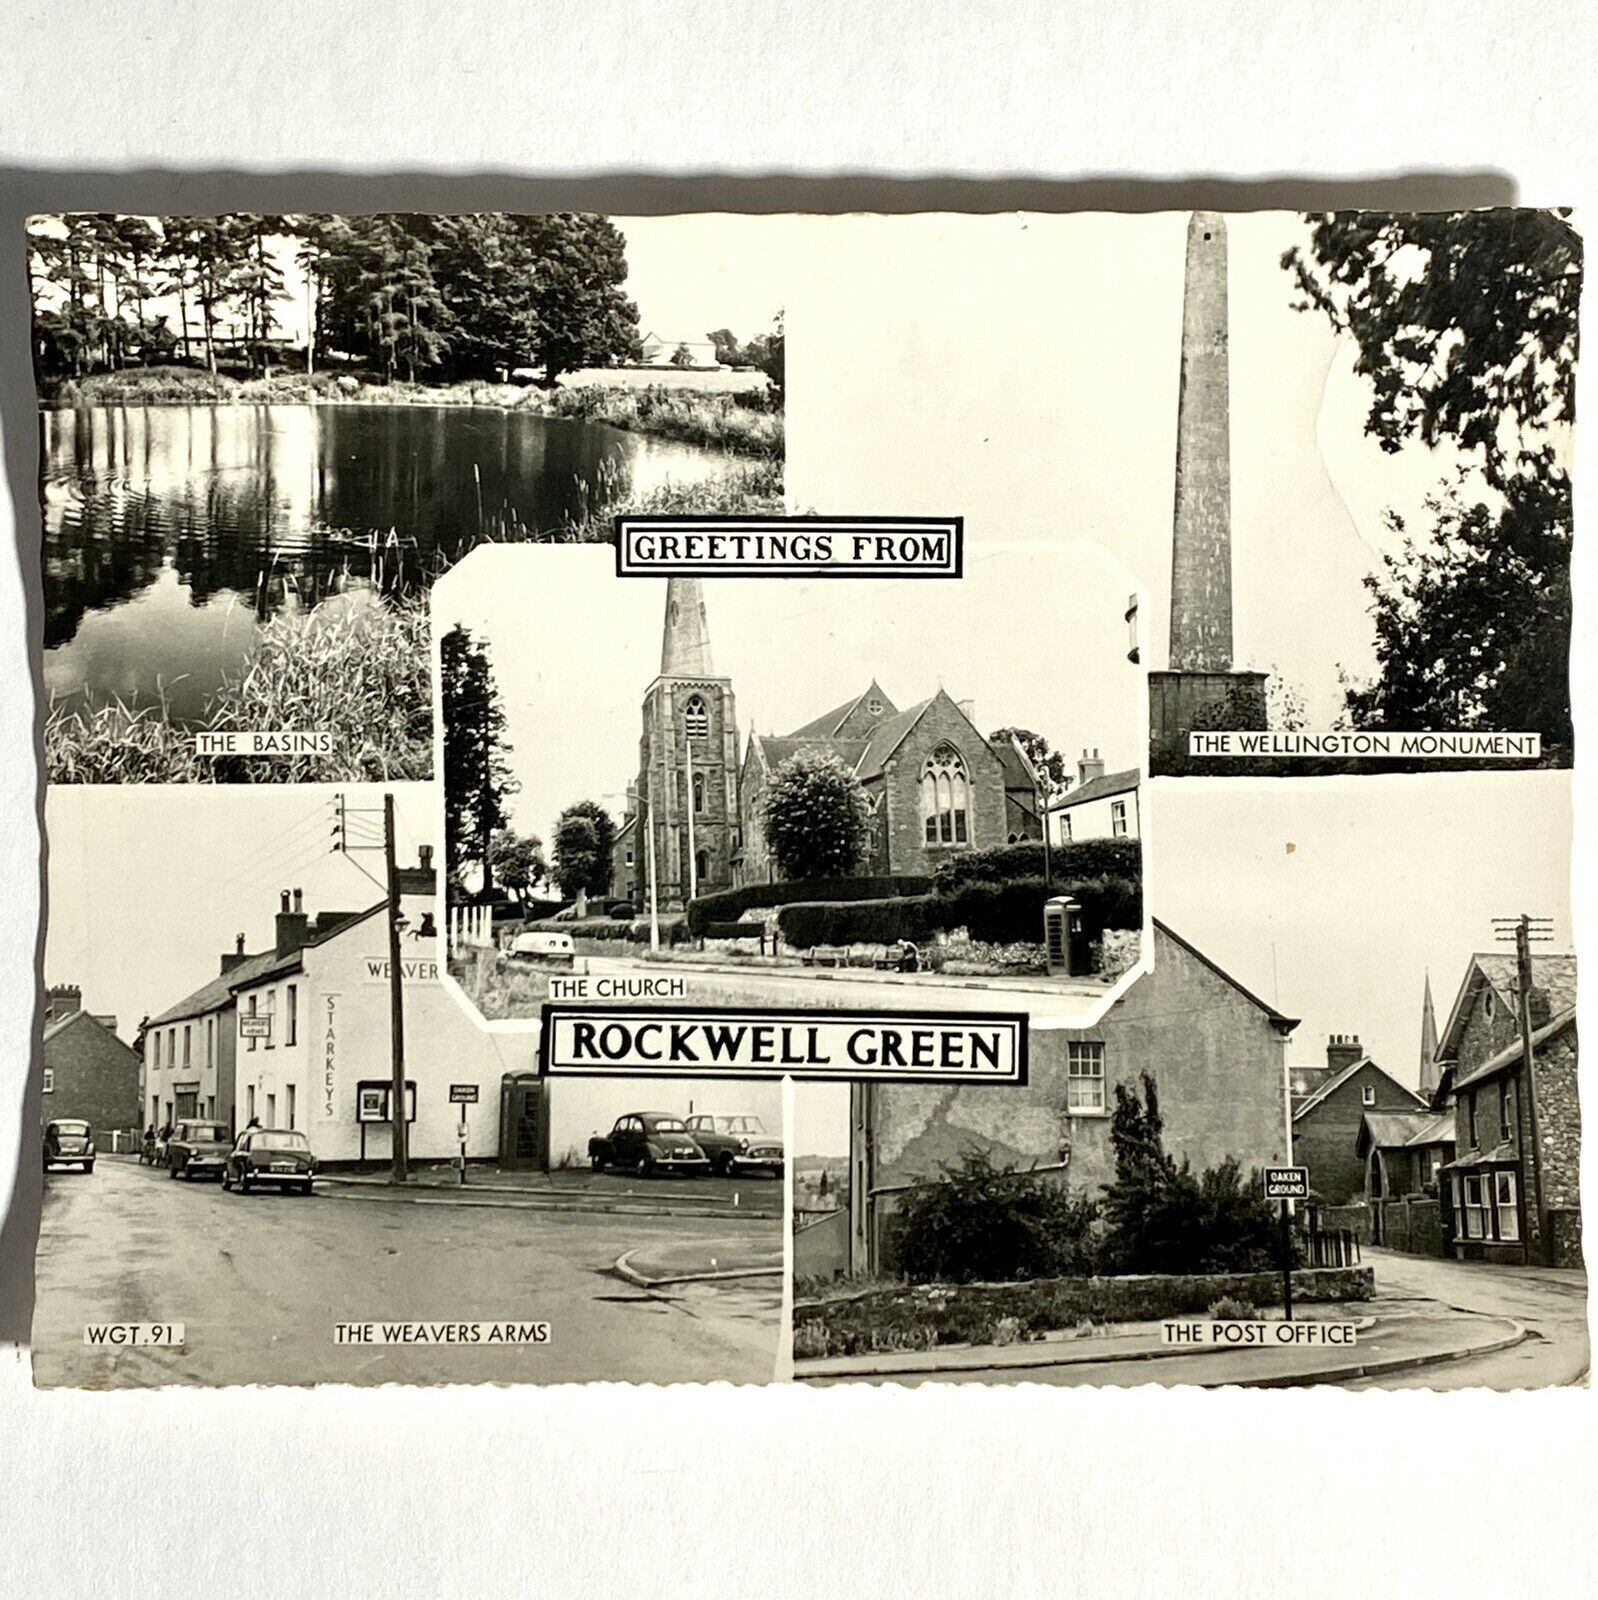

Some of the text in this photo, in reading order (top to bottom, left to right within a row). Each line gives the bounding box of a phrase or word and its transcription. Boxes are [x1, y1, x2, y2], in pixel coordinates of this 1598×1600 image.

[634, 535, 946, 562] GREETINGS FROM
[200, 735, 330, 752] THE BASINS
[1193, 735, 1536, 754] THE WELLINGTON MONUMENT
[551, 978, 685, 998] THE CHURCH
[572, 1022, 1002, 1070] ROCKWELL GREEN
[325, 996, 336, 1116] STARKEYS
[1270, 1171, 1302, 1182] OAKEN
[1268, 1183, 1305, 1195] GROUND
[335, 1325, 547, 1343] THE WEAVERS ARMS
[1164, 1323, 1354, 1344] THE POST OFFICE
